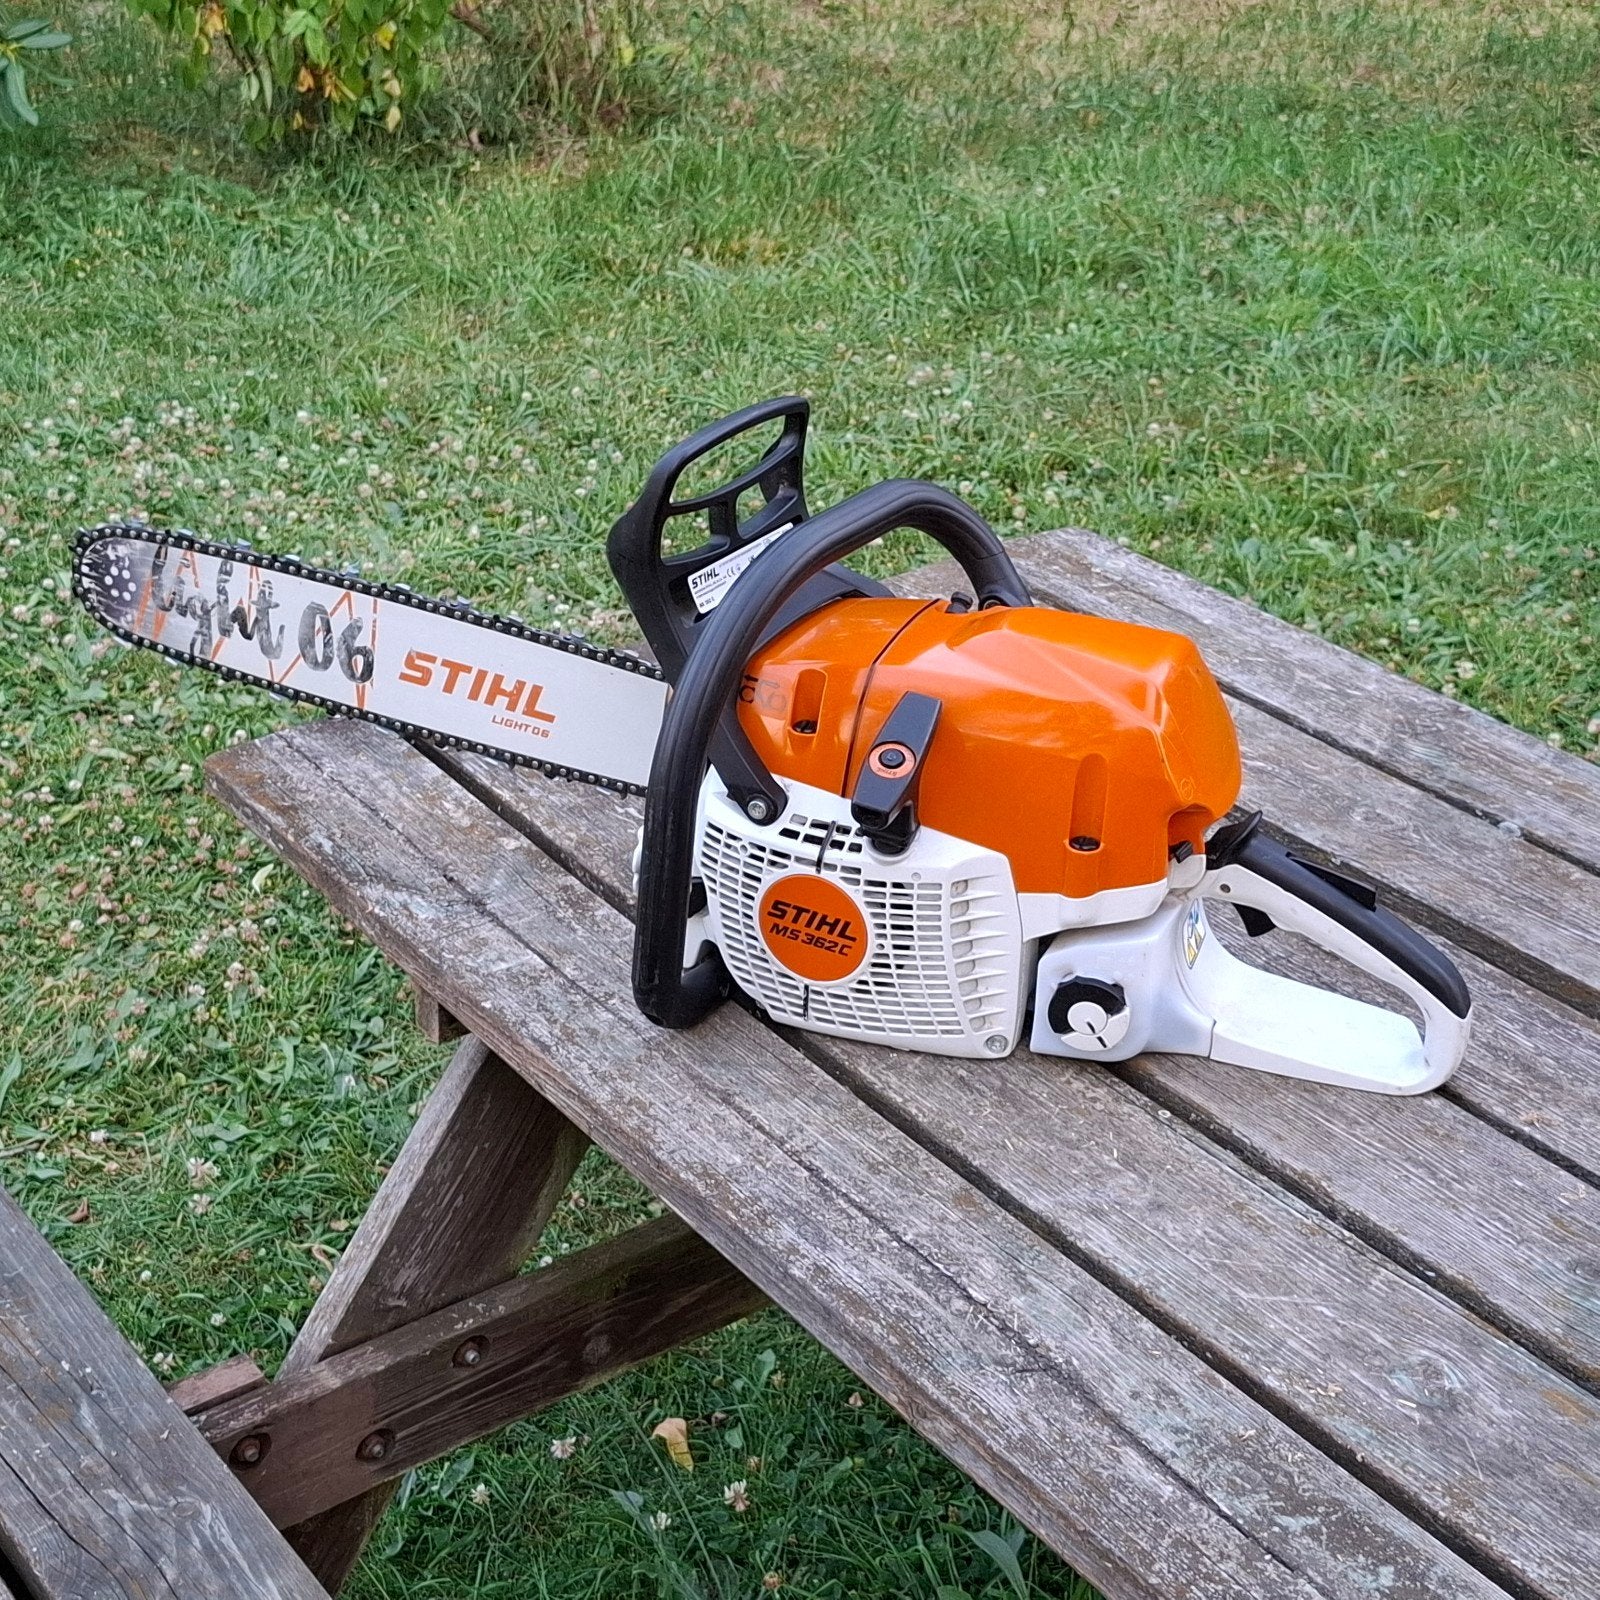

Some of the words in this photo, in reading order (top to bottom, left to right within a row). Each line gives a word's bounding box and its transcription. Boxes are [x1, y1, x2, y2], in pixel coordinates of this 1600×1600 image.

[691, 566, 720, 590] STIHL
[298, 601, 375, 684] 06
[398, 650, 556, 724] STIHL
[767, 899, 858, 942] STIHL
